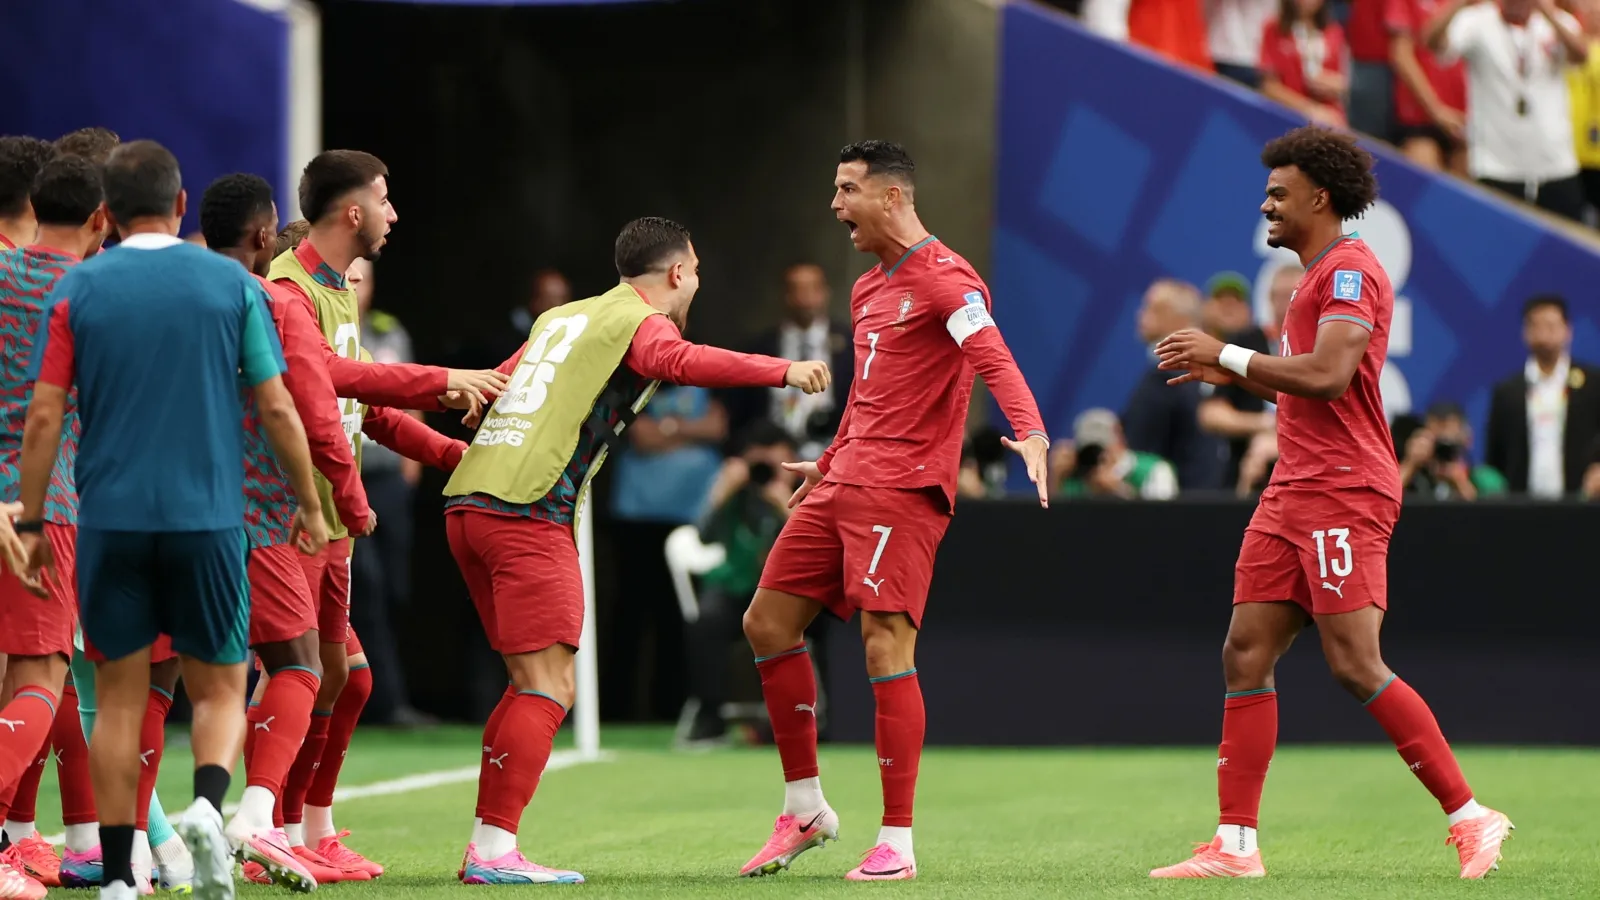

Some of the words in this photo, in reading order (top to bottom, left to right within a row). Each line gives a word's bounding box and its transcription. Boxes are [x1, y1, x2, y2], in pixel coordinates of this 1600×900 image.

[862, 332, 880, 380] 7
[509, 416, 532, 430] CUP
[868, 525, 893, 574] 7
[1312, 528, 1353, 578] 13
